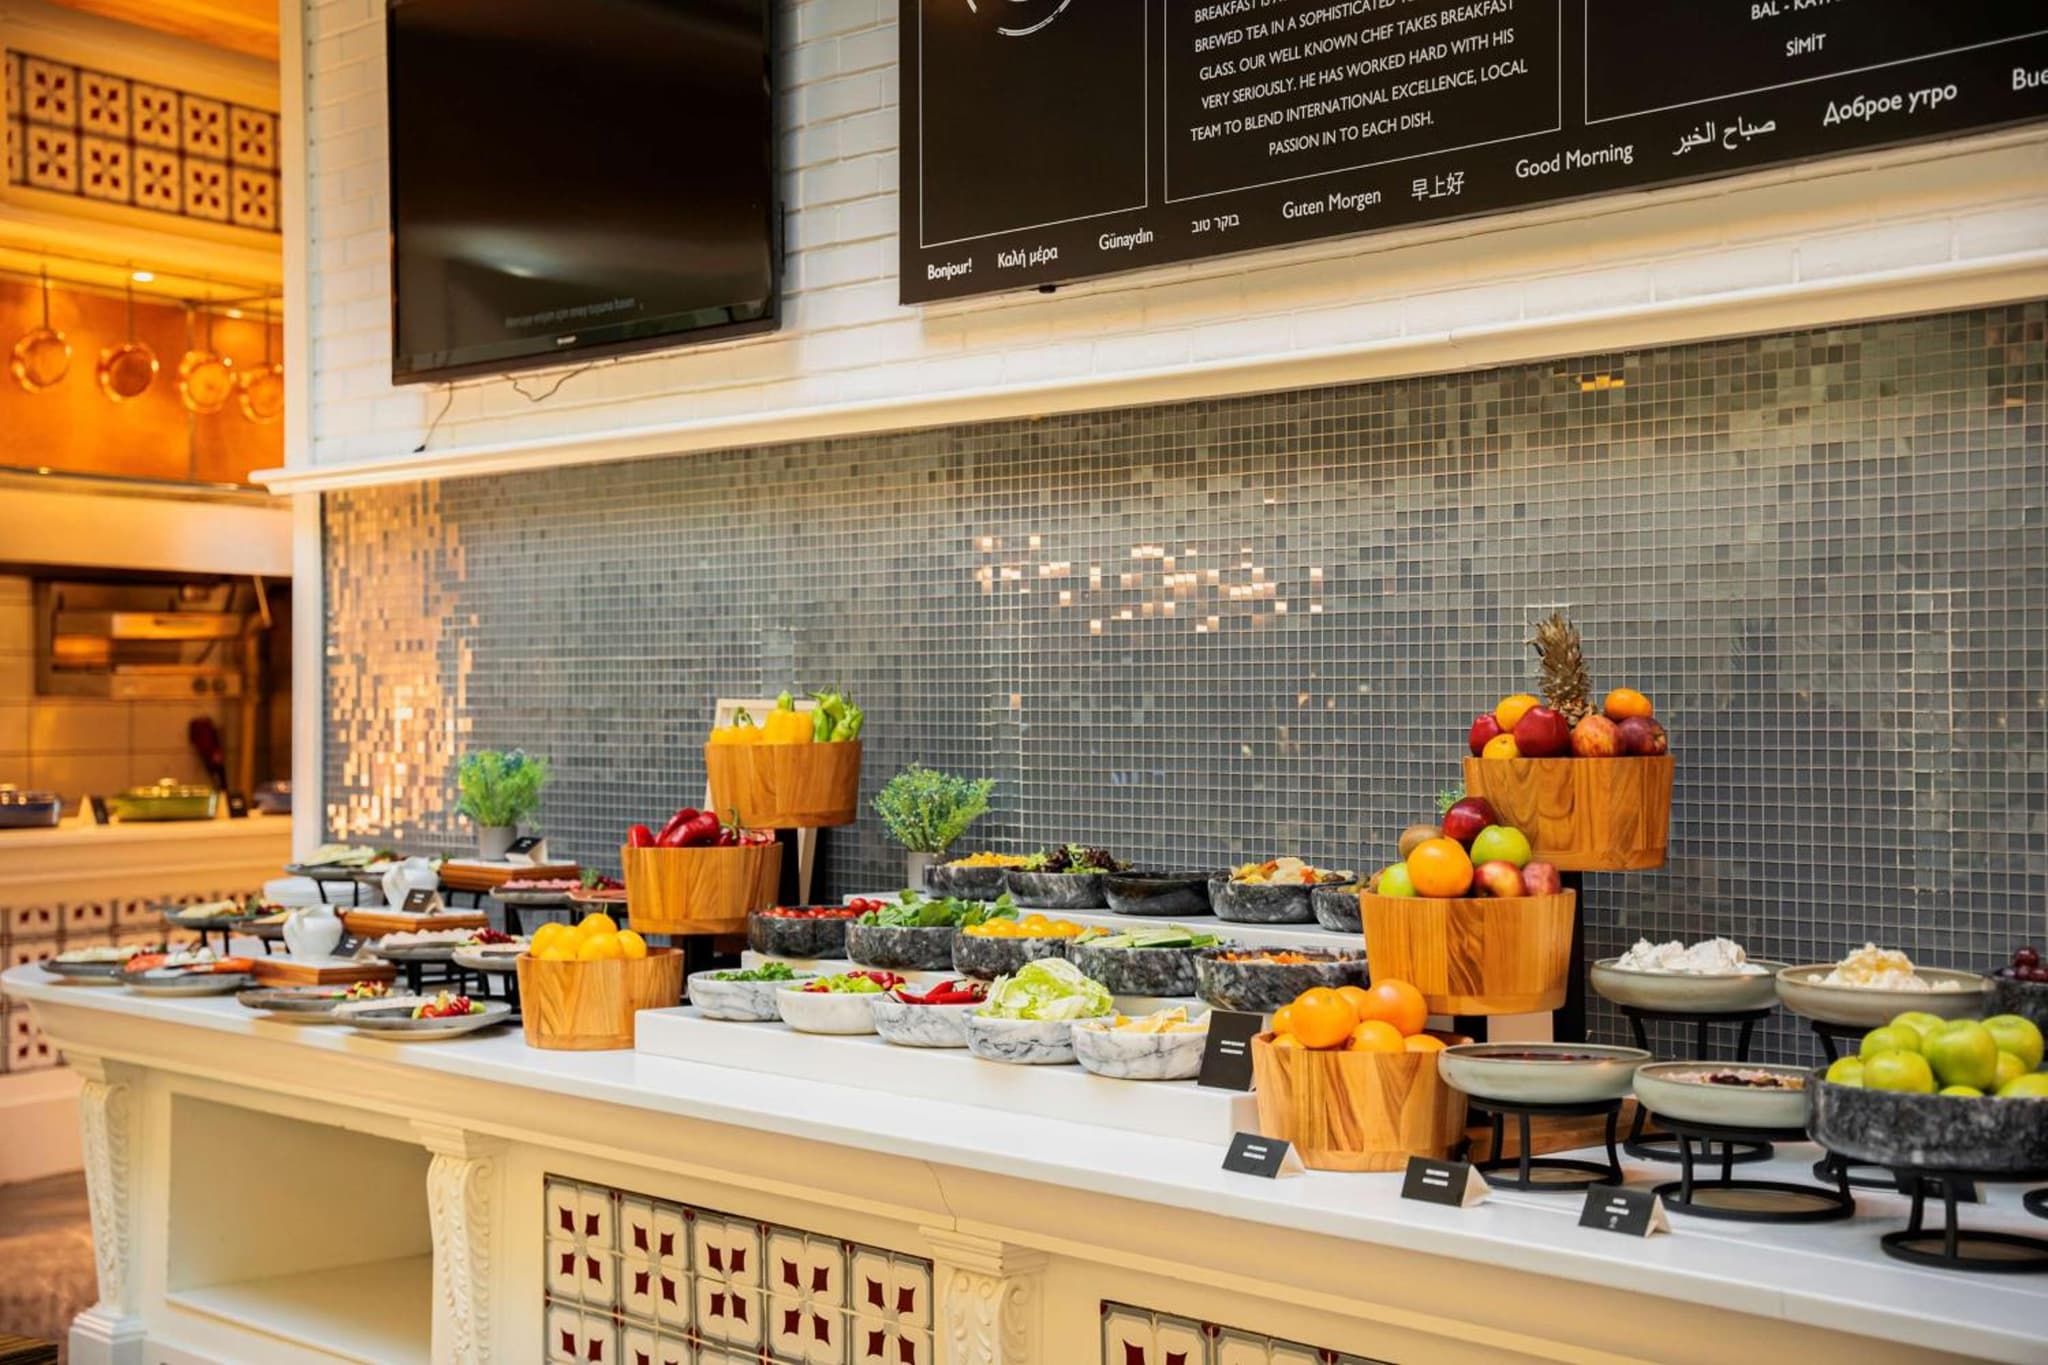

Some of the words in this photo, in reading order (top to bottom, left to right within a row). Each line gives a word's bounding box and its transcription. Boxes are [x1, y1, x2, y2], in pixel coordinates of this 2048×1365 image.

[1194, 0, 1257, 23] BREAKFAST
[1195, 30, 1243, 52] BREWED
[1246, 24, 1269, 40] TEA
[1271, 19, 1285, 34] IN
[1287, 17, 1297, 30] A
[1299, 0, 1396, 28] SOPHISTICATED
[1751, 0, 1780, 20] BAL
[1199, 61, 1237, 80] GLASS.
[1239, 54, 1267, 71] OUR
[1269, 46, 1302, 64] WELL
[1304, 32, 1358, 56] KNOWN
[1361, 24, 1394, 43] CHEF
[1397, 13, 1438, 35] TAKES
[1441, 0, 1515, 25] BREAKFAST
[1201, 92, 1230, 109] VERY
[1232, 78, 1297, 103] SERIOUSLY.
[1300, 73, 1316, 88] HE
[1318, 67, 1343, 84] HAS
[1346, 54, 1406, 77] WORKED
[1409, 44, 1448, 64] HARD
[1450, 34, 1489, 54] WITH
[1492, 28, 1515, 46] HIS
[1190, 124, 1222, 141] TEAM
[1224, 120, 1242, 134] TO
[1244, 111, 1284, 130] BLEND
[1286, 89, 1389, 122] INTERNATIONAL
[1392, 70, 1478, 100] EXCELLENCE,
[1481, 59, 1529, 81] LOCAL
[1822, 95, 1903, 127] Доброе
[1908, 84, 1958, 114] утро
[1269, 134, 1320, 156] PASSION
[1323, 130, 1337, 144] IN
[1339, 126, 1359, 141] TO
[1362, 118, 1398, 137] EACH
[1400, 111, 1435, 130] DISH.
[1671, 121, 1716, 155] الخير
[1722, 116, 1776, 149] صباح
[1516, 153, 1561, 178] Good
[1565, 143, 1634, 170] Morning
[1411, 172, 1465, 201] 早上好
[1283, 199, 1325, 219] Guten
[1329, 190, 1382, 213] Morgen
[1098, 227, 1154, 251] Günaydın
[1191, 219, 1211, 233] טוב
[927, 256, 972, 282] Bonjour!
[997, 248, 1027, 268] Καλή
[1029, 246, 1059, 266] μέρα
